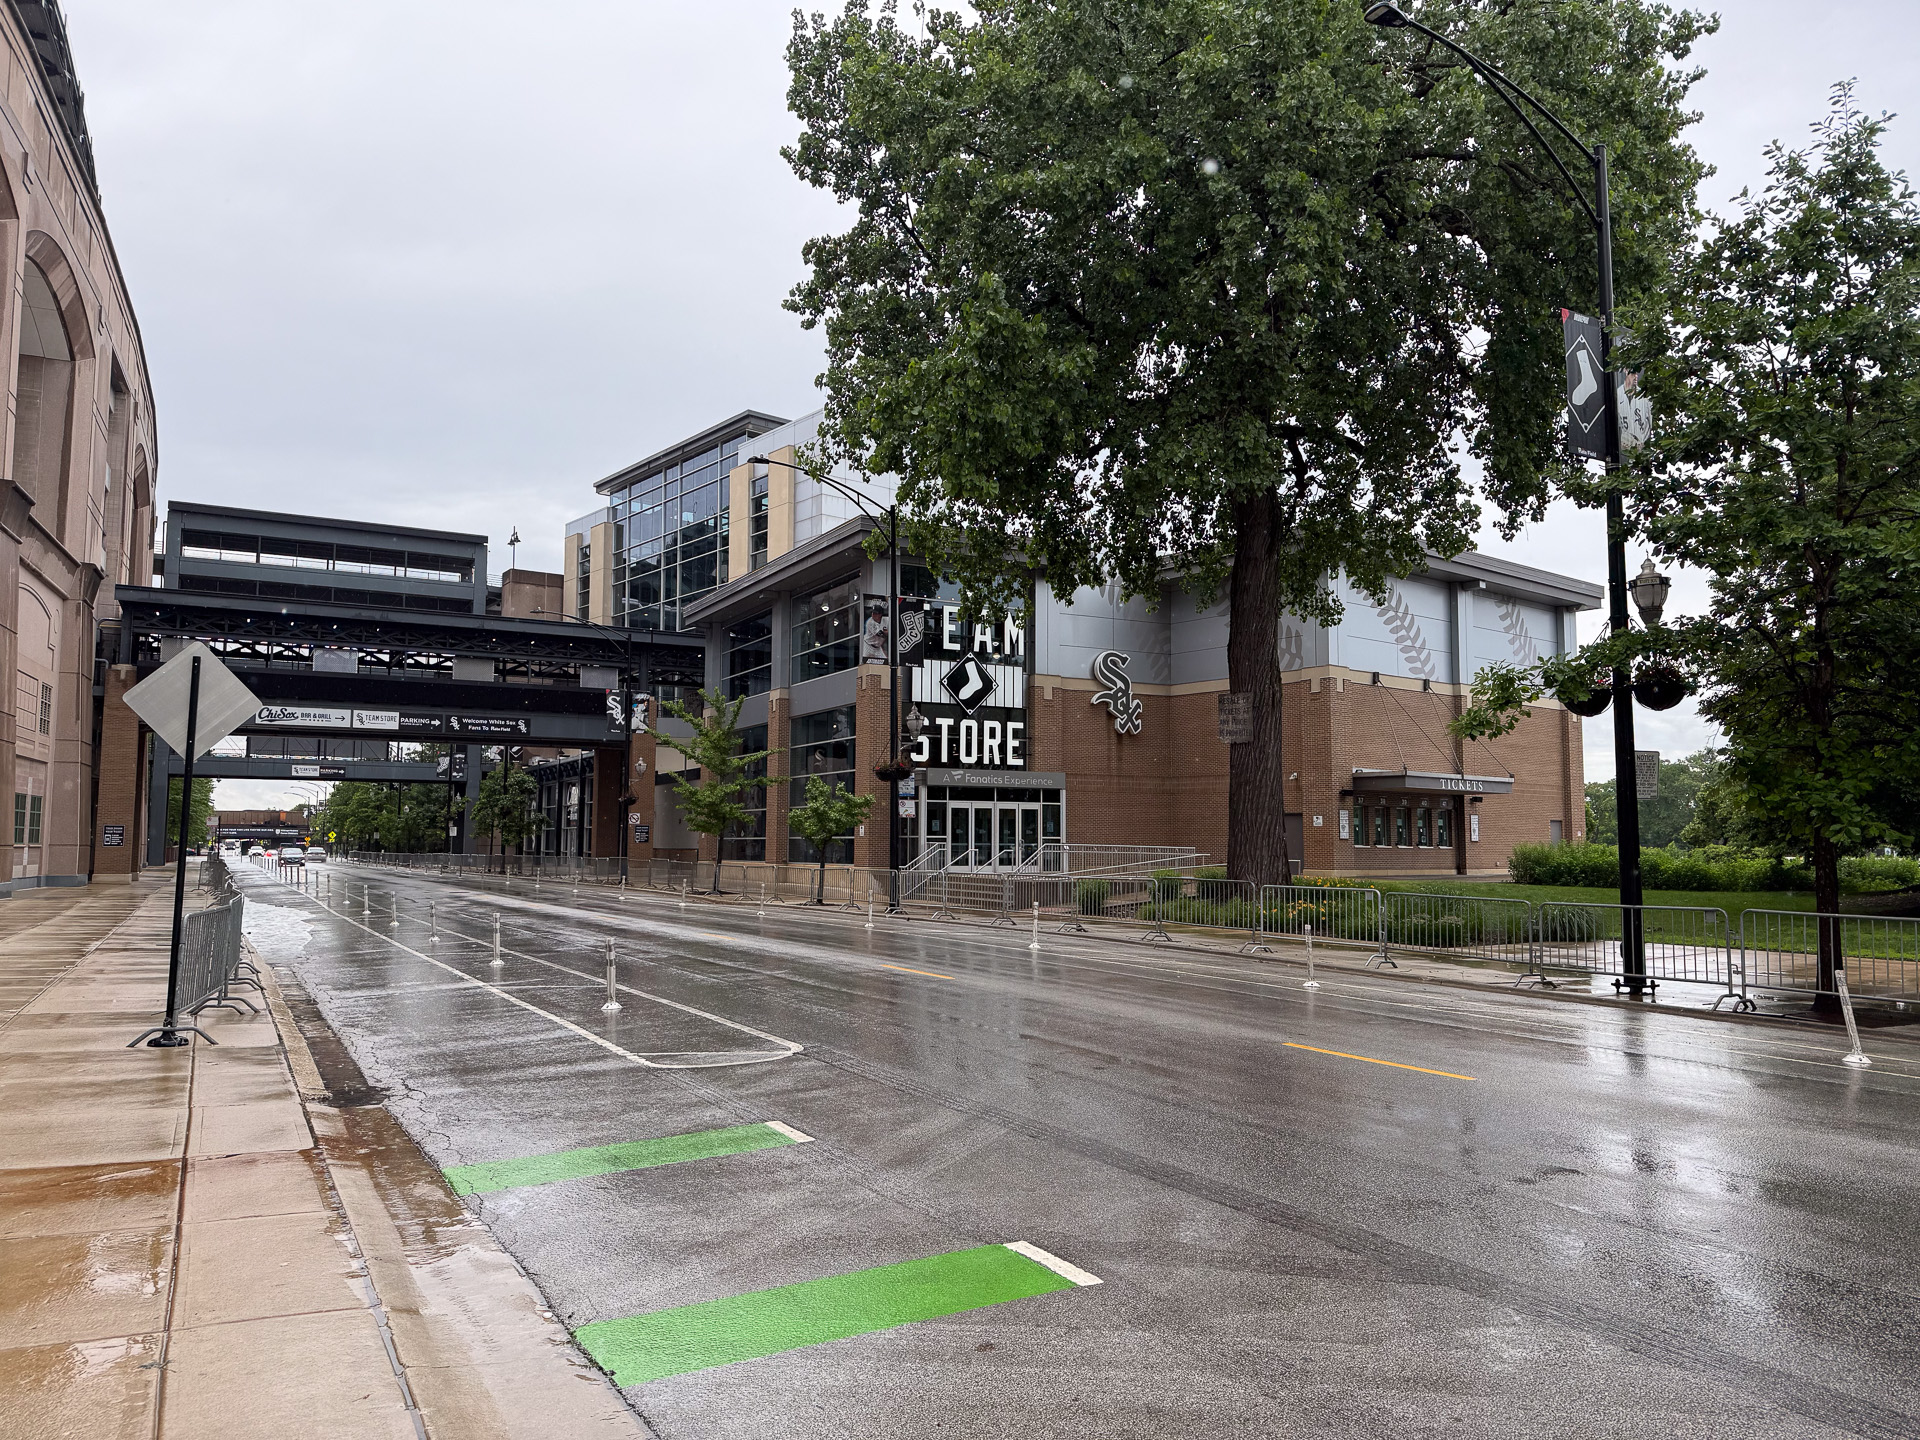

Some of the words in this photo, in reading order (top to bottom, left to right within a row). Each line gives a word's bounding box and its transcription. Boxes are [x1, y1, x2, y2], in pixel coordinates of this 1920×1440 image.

[900, 614, 918, 649] CHICAGO
[924, 603, 1024, 656] EAM
[365, 714, 379, 722] TEAM
[910, 717, 1024, 766] STORE
[943, 774, 950, 782] A
[965, 773, 1003, 784] Fanatics
[1004, 775, 1053, 787] Experience
[1440, 779, 1483, 791] TICKETS
